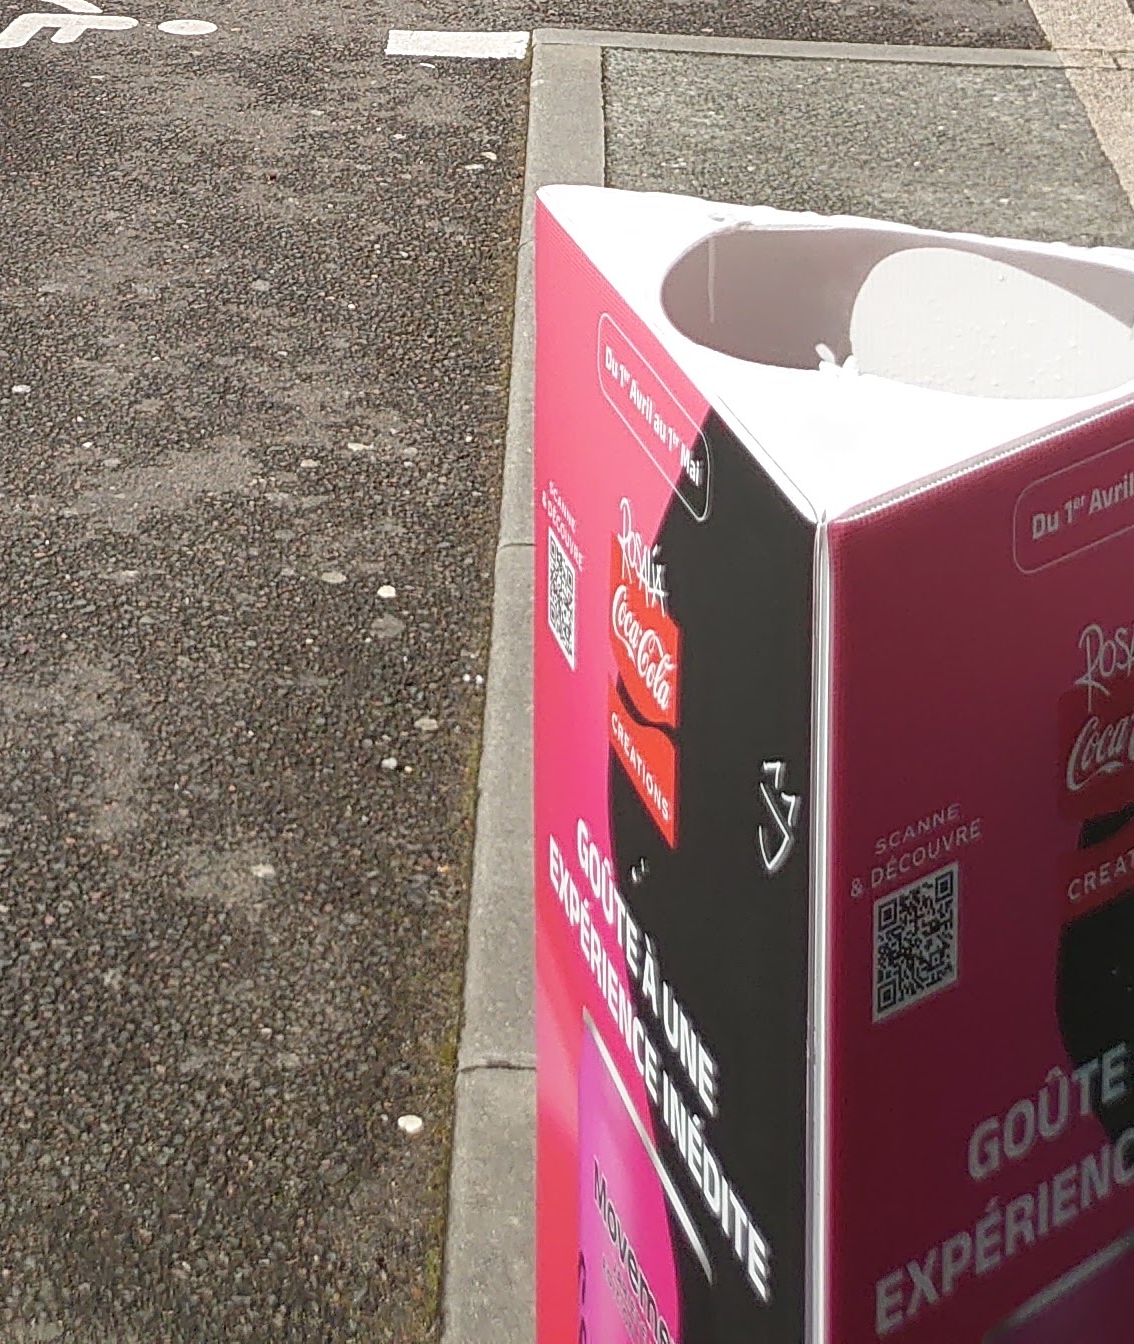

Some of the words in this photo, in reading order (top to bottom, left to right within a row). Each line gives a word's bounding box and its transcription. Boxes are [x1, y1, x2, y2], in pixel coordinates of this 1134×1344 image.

[605, 345, 618, 379] Du
[629, 379, 653, 425] Avril
[653, 413, 666, 443] au
[680, 443, 700, 487] Mai
[1032, 511, 1059, 540] Du
[611, 712, 670, 821] CREATIONS
[850, 878, 864, 897] &
[871, 817, 981, 889] DÉCOUVRE
[875, 803, 962, 855] SCANNE
[577, 817, 640, 979] GOÛTE
[642, 932, 659, 1017] À
[663, 980, 716, 1115] UNE
[549, 833, 660, 1105] EXPÉRIENCE
[663, 1069, 769, 1302] INÉDITE
[969, 1043, 1127, 1180] GOÛTE
